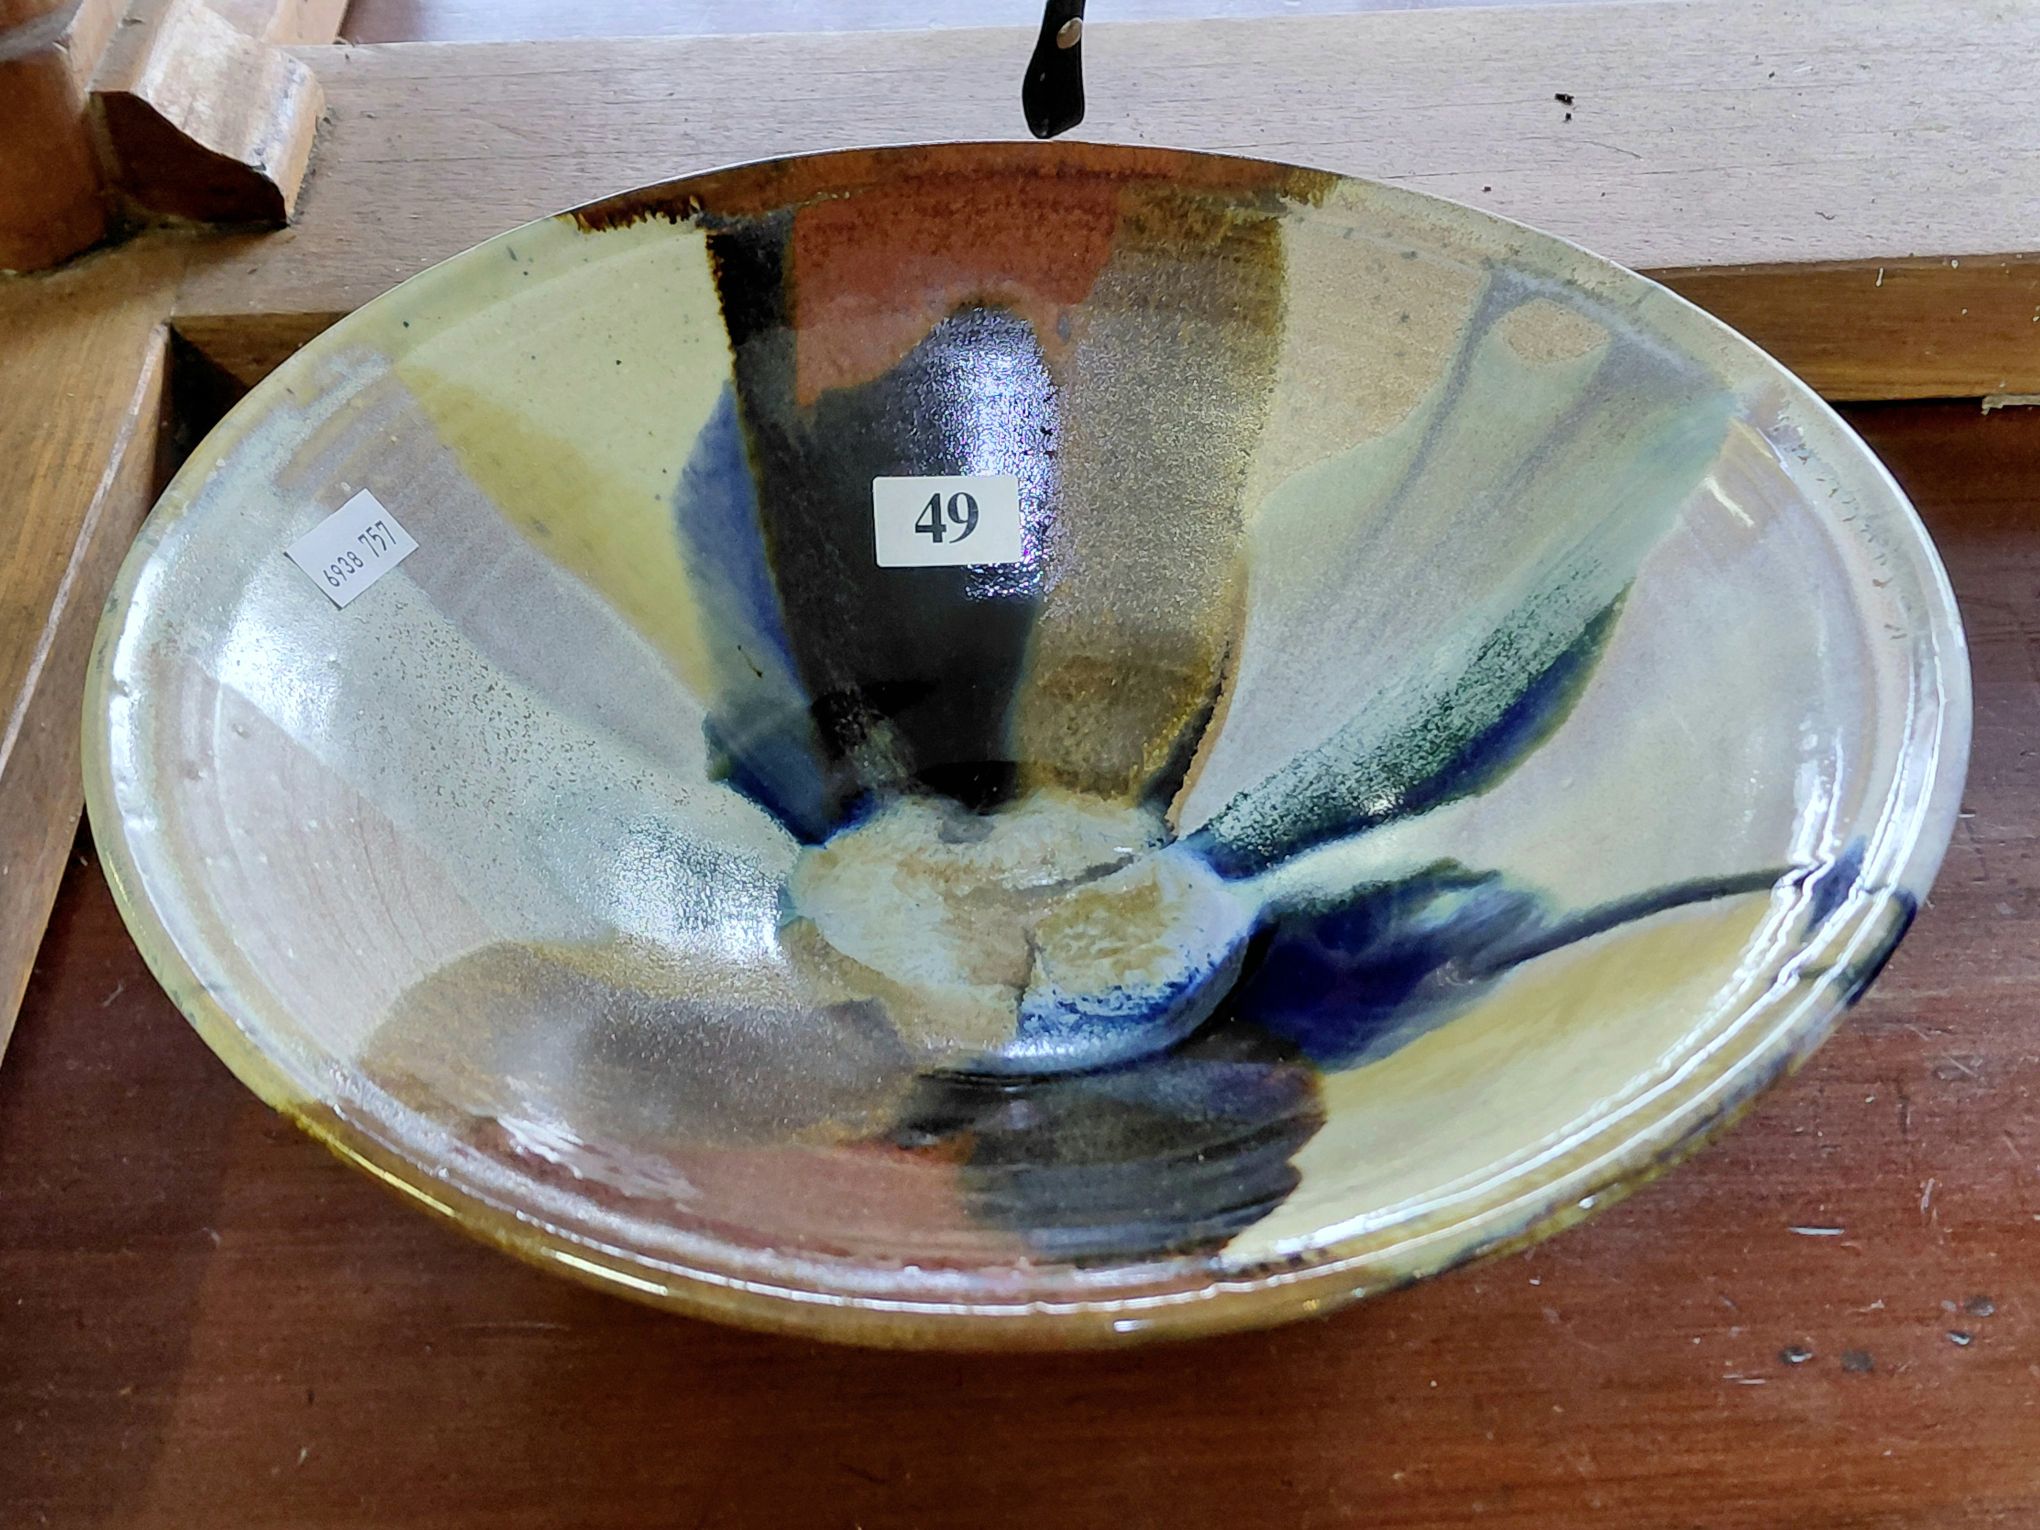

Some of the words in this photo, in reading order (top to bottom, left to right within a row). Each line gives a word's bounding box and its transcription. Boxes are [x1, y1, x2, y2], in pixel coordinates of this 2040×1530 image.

[914, 491, 979, 544] 49
[323, 551, 364, 588] 6938
[357, 520, 397, 558] 757
